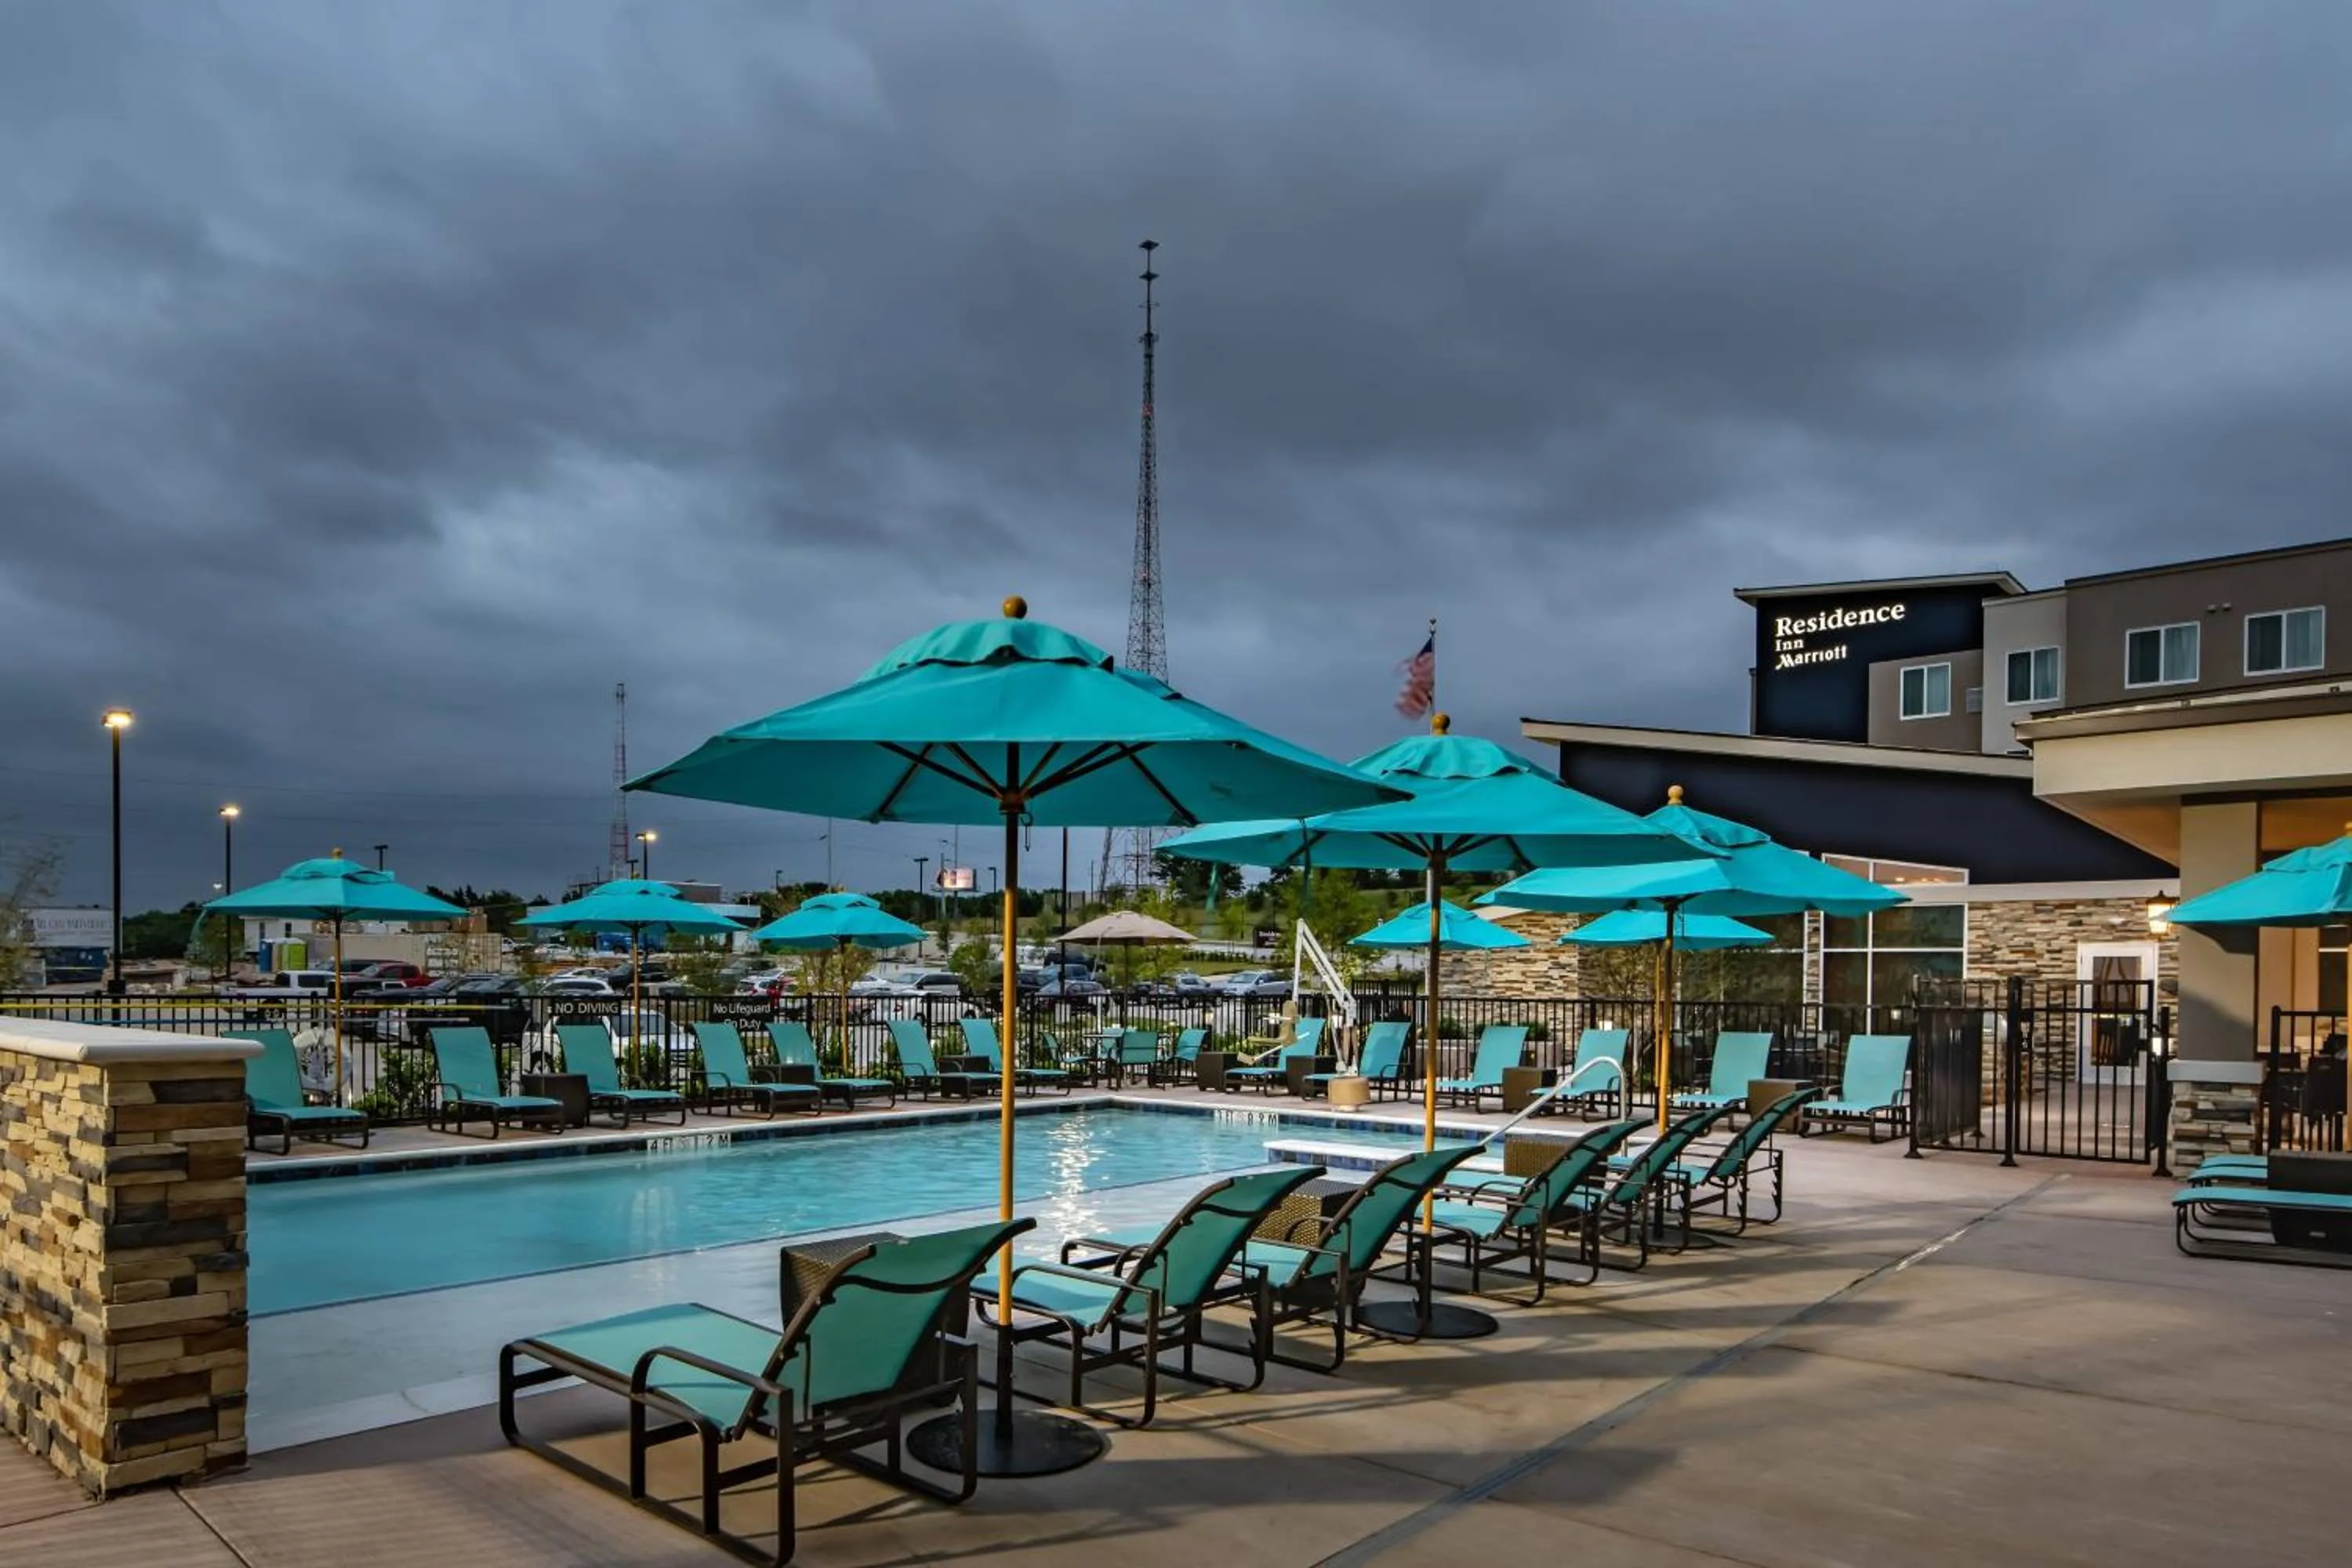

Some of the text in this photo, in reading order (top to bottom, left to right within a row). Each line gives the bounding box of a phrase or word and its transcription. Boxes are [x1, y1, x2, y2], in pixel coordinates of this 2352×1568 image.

[1775, 603, 1906, 637] Residence
[1775, 639, 1804, 652] Inn
[1775, 644, 1848, 670] Marriott
[554, 1003, 619, 1014] NO DIVING
[713, 1002, 771, 1017] No Lifeguard
[739, 1018, 761, 1031] Duty
